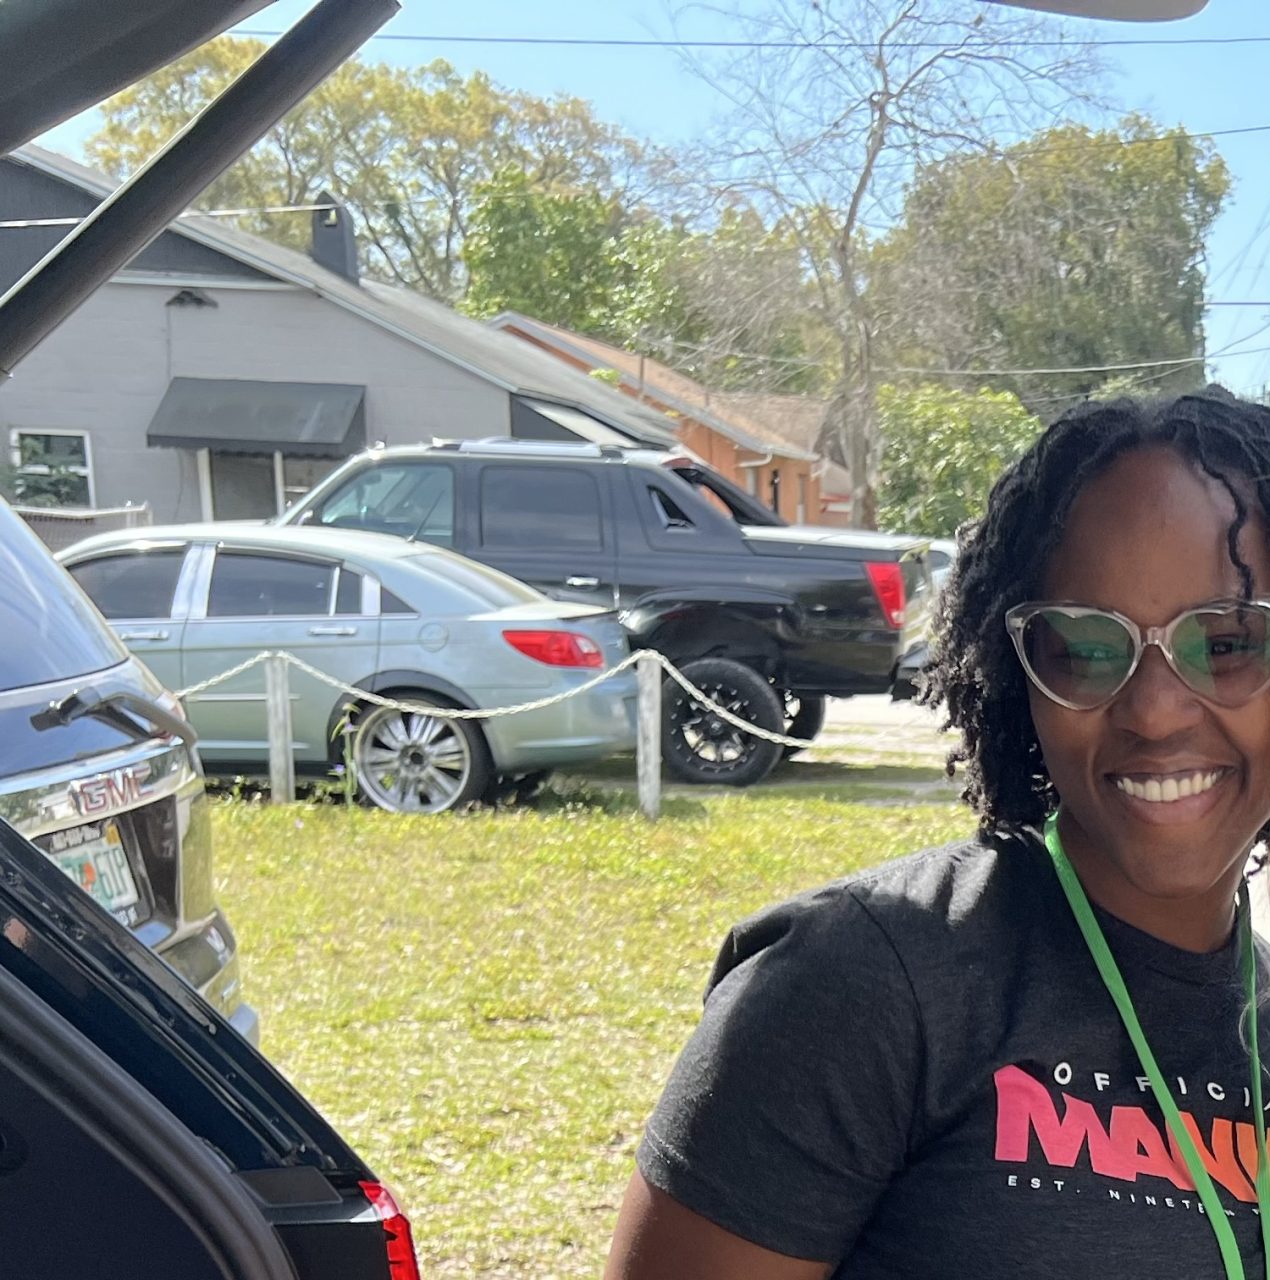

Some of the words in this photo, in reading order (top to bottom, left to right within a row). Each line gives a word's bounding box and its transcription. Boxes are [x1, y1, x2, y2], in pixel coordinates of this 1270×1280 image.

[77, 765, 155, 813] GMC
[1008, 1175, 1081, 1193] EST.
[1109, 1189, 1235, 1216] NINETEN
